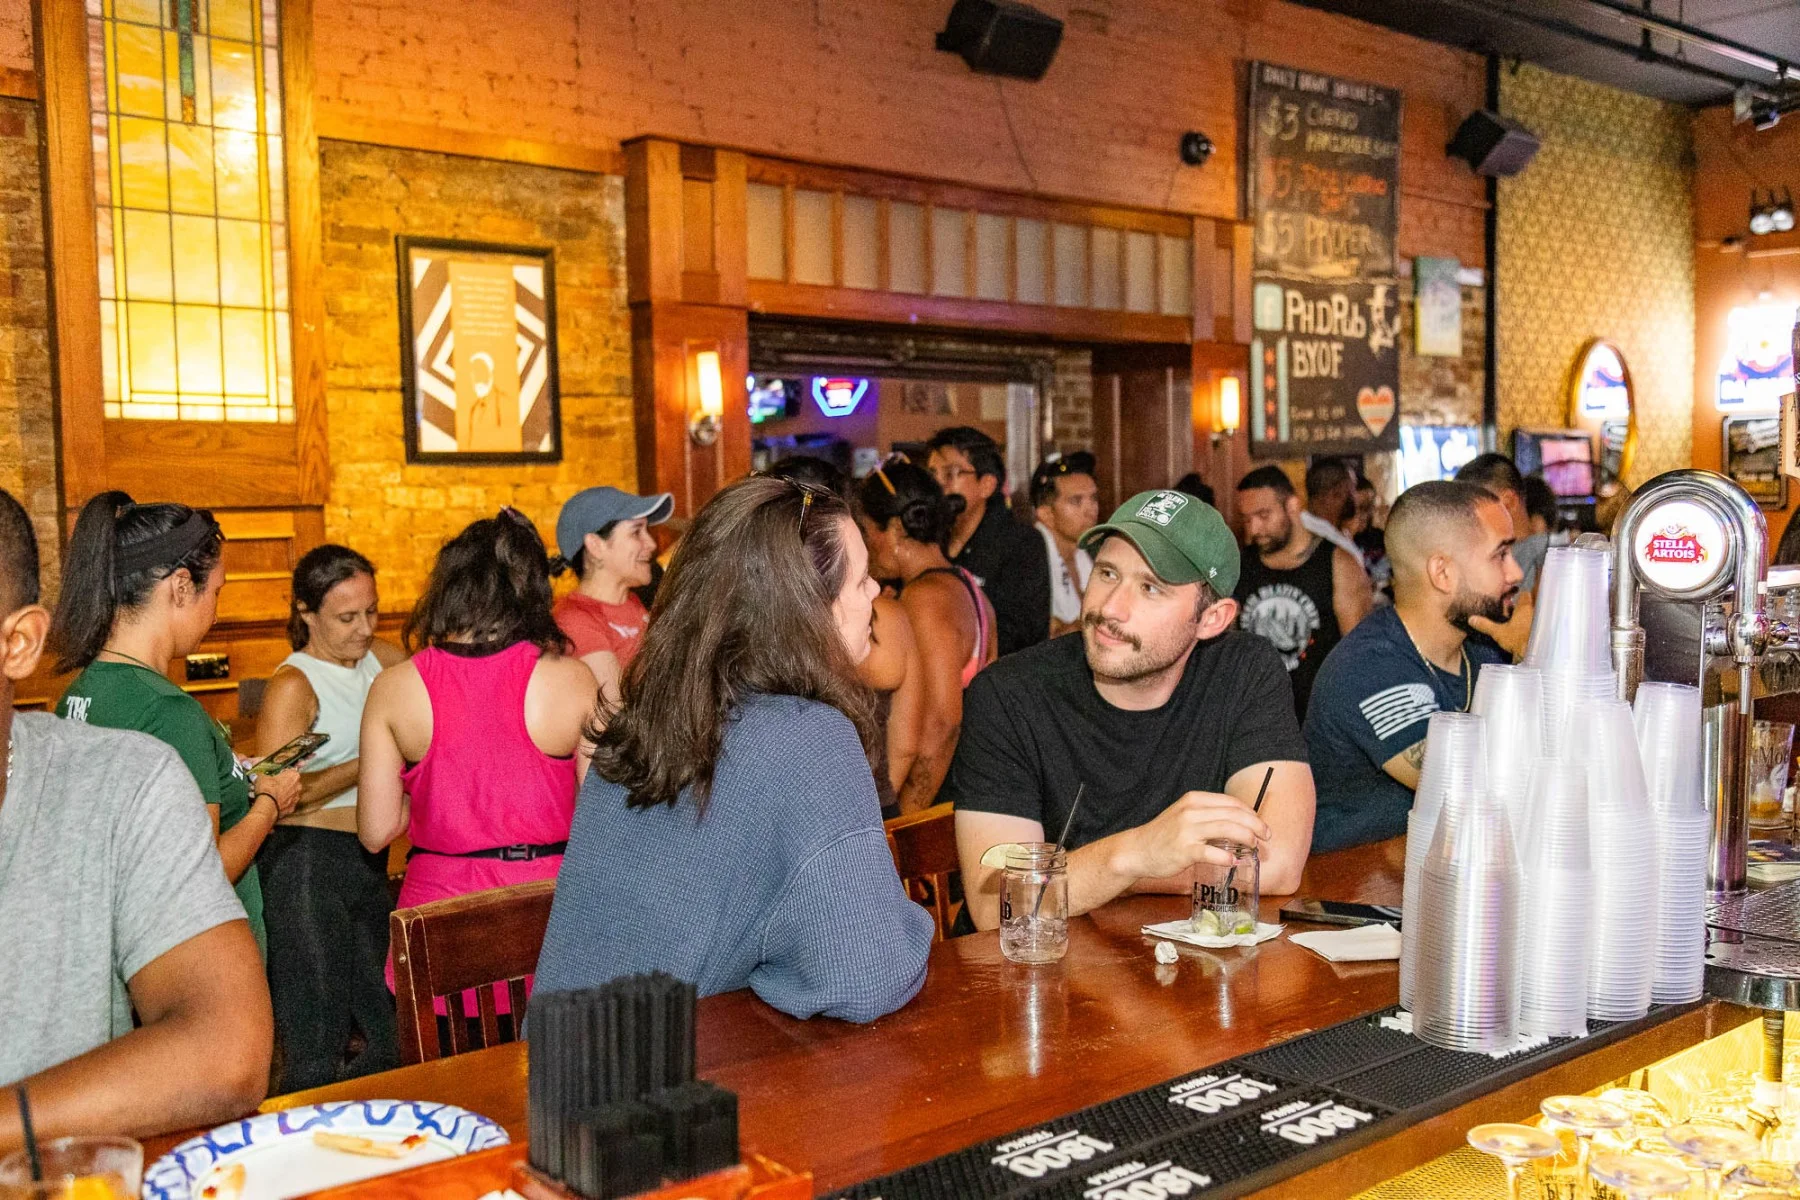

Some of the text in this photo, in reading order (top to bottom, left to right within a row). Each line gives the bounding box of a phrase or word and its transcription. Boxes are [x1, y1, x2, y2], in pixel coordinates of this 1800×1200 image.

[1292, 341, 1344, 378] BYOF
[1652, 539, 1695, 549] STELLA
[1652, 550, 1695, 559] ARTOIS
[1184, 1077, 1278, 1114] 1800
[1278, 1105, 1374, 1145] 1800
[1007, 1134, 1114, 1178] 1800
